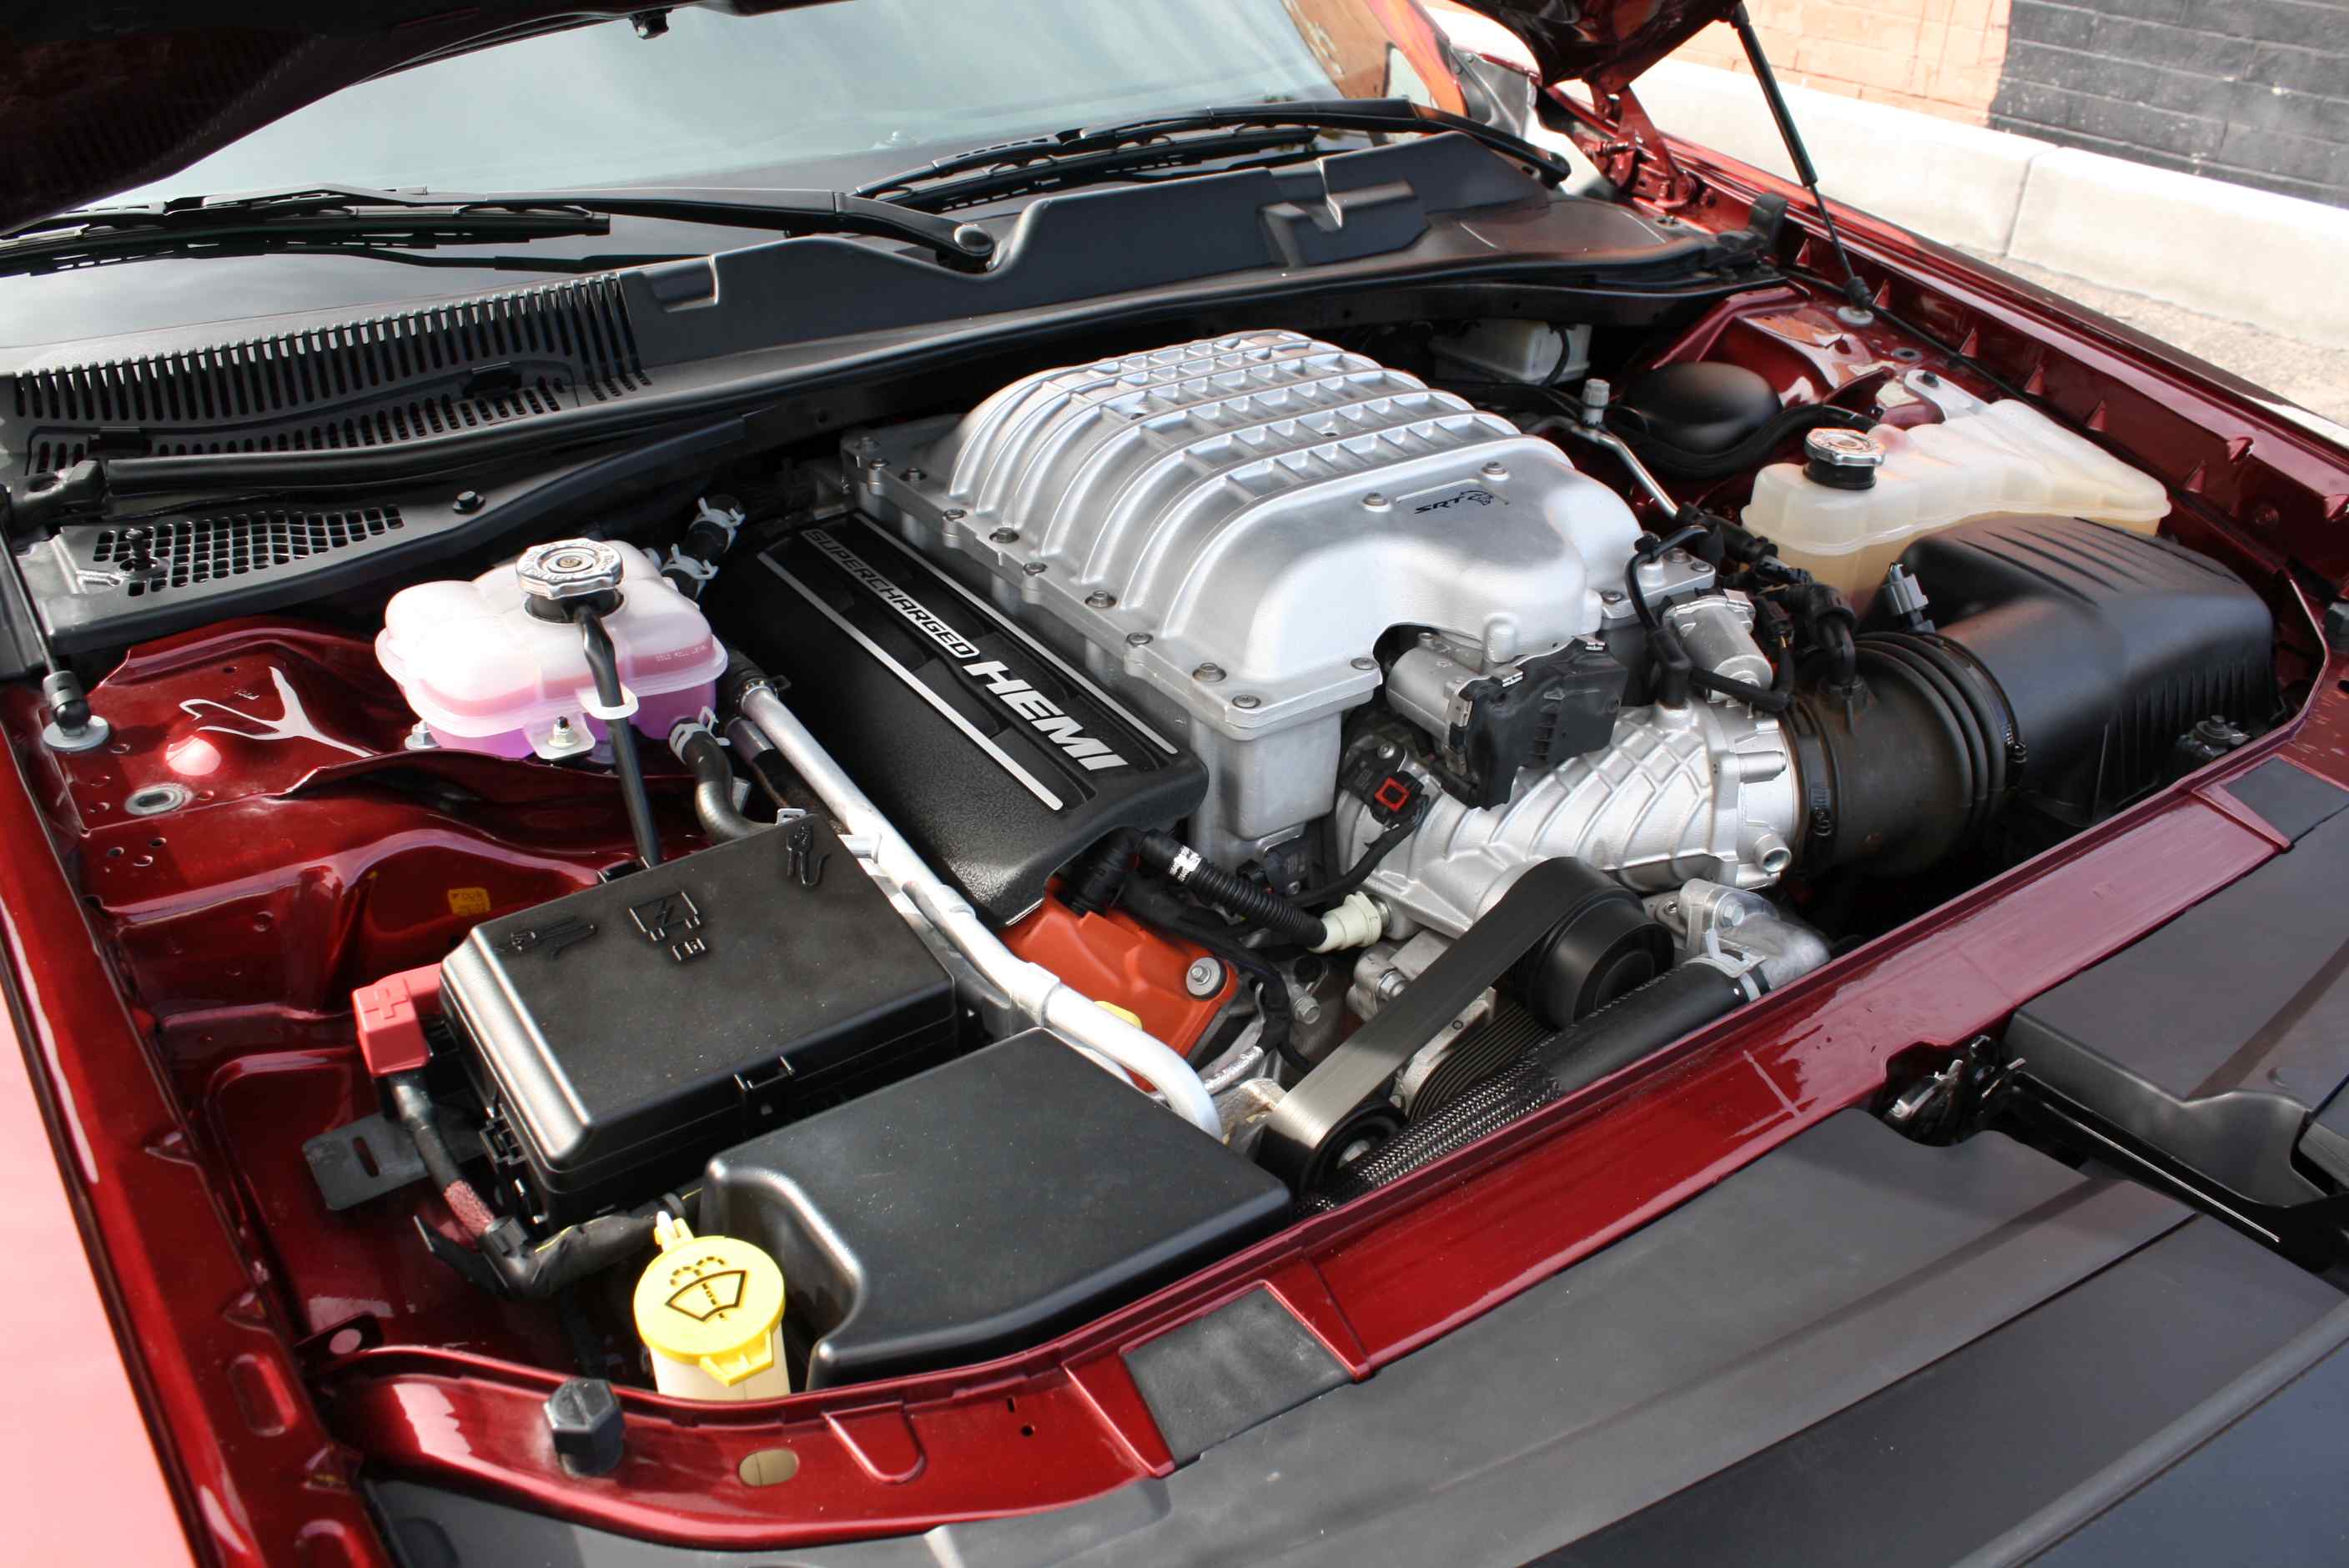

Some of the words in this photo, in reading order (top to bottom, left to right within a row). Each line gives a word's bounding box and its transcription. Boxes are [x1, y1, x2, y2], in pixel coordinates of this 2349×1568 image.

[1414, 495, 1464, 514] SRT
[807, 530, 976, 656] SUPERCHARGED
[963, 661, 1129, 771] HEMI
